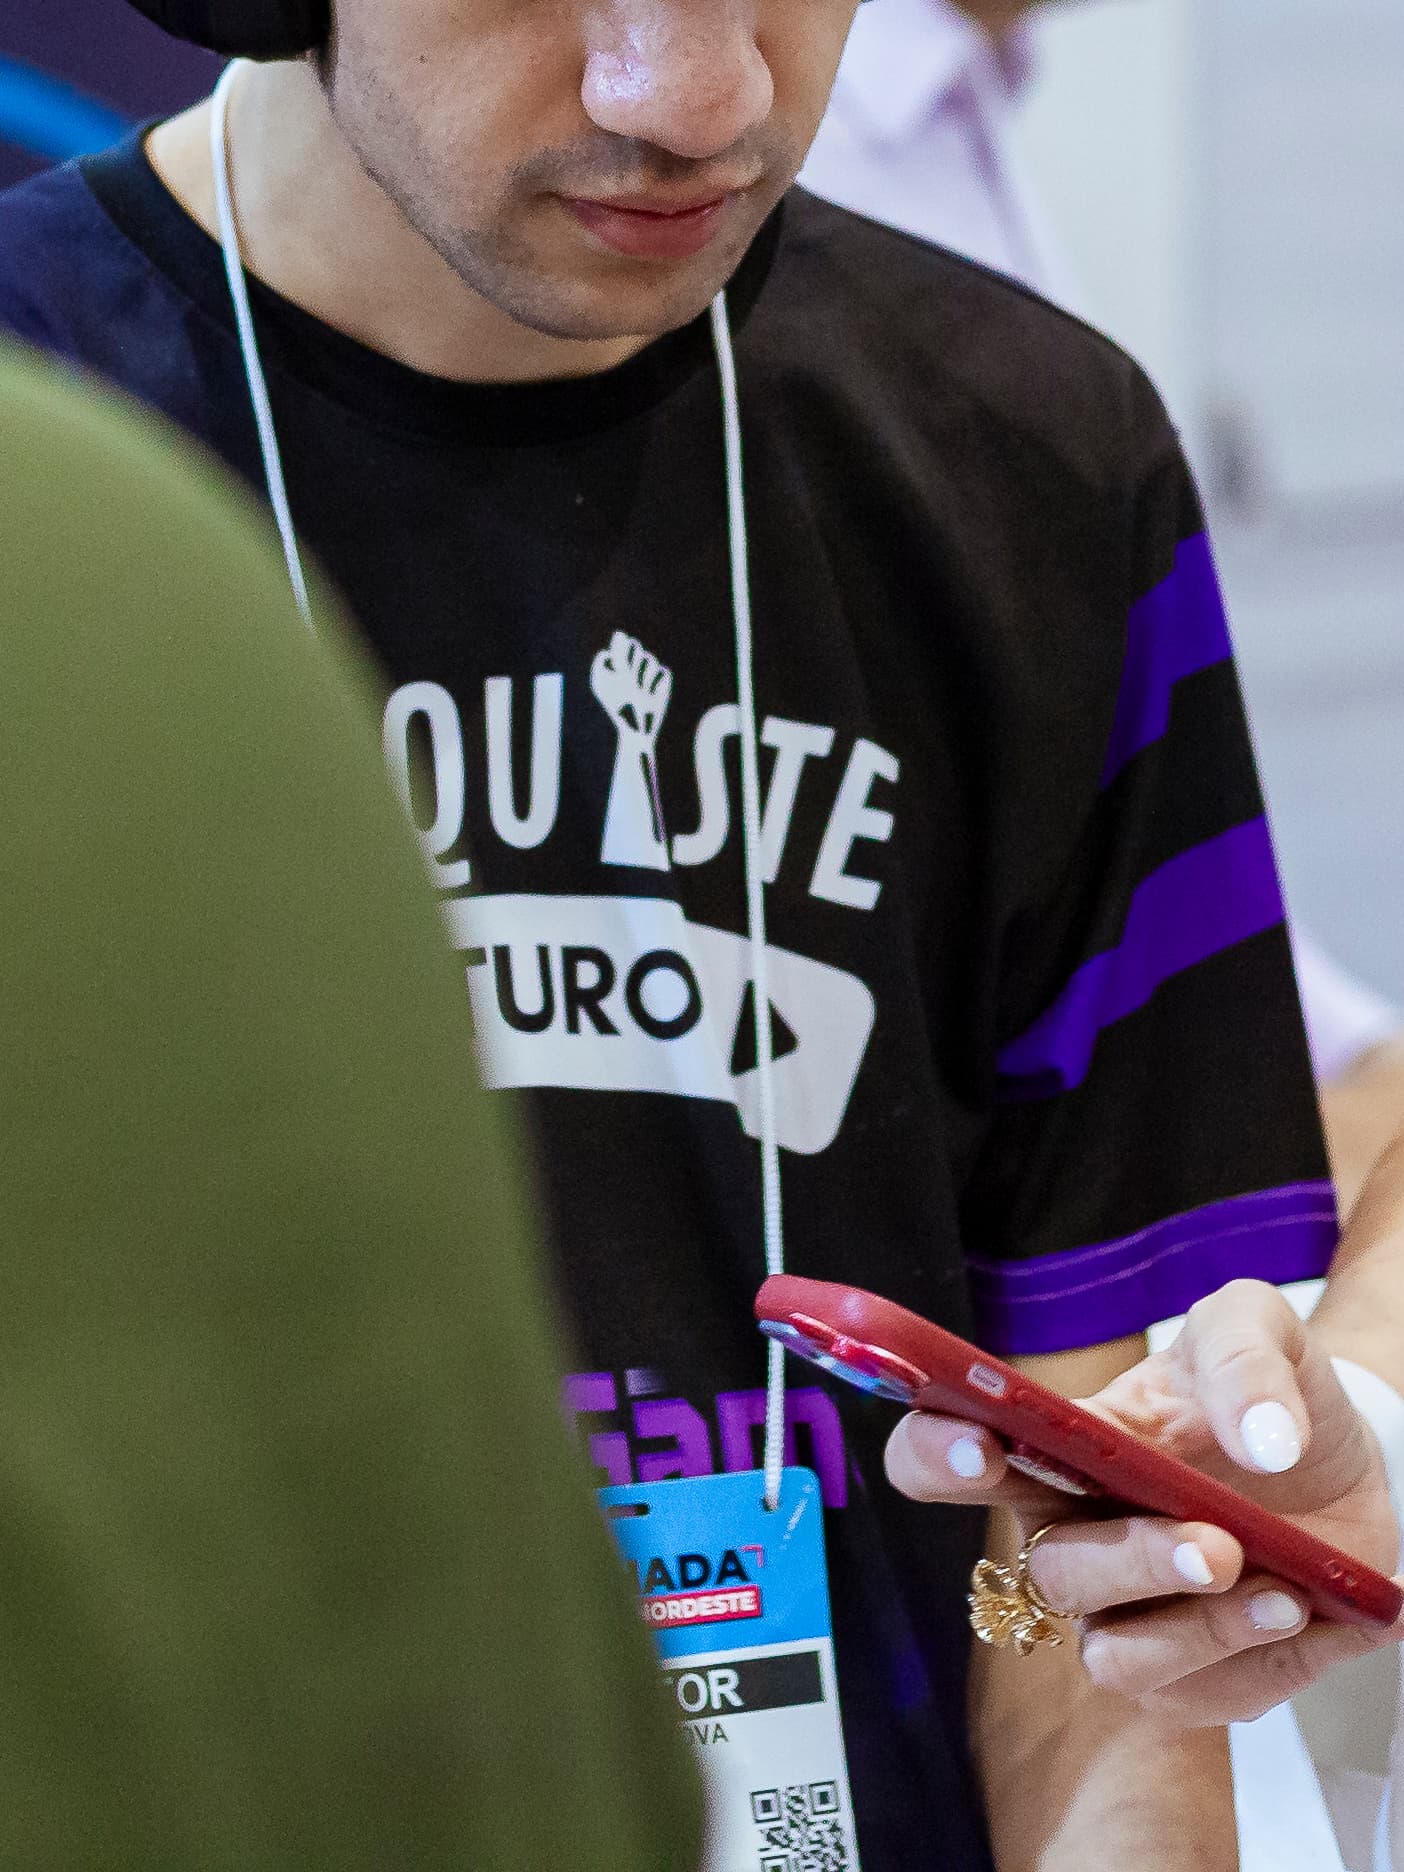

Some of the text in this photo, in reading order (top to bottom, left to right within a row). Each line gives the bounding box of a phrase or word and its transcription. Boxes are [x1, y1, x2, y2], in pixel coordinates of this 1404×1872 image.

[631, 1549, 752, 1592] ADA
[641, 1590, 757, 1621] ORDESTE
[666, 1668, 744, 1714] OR
